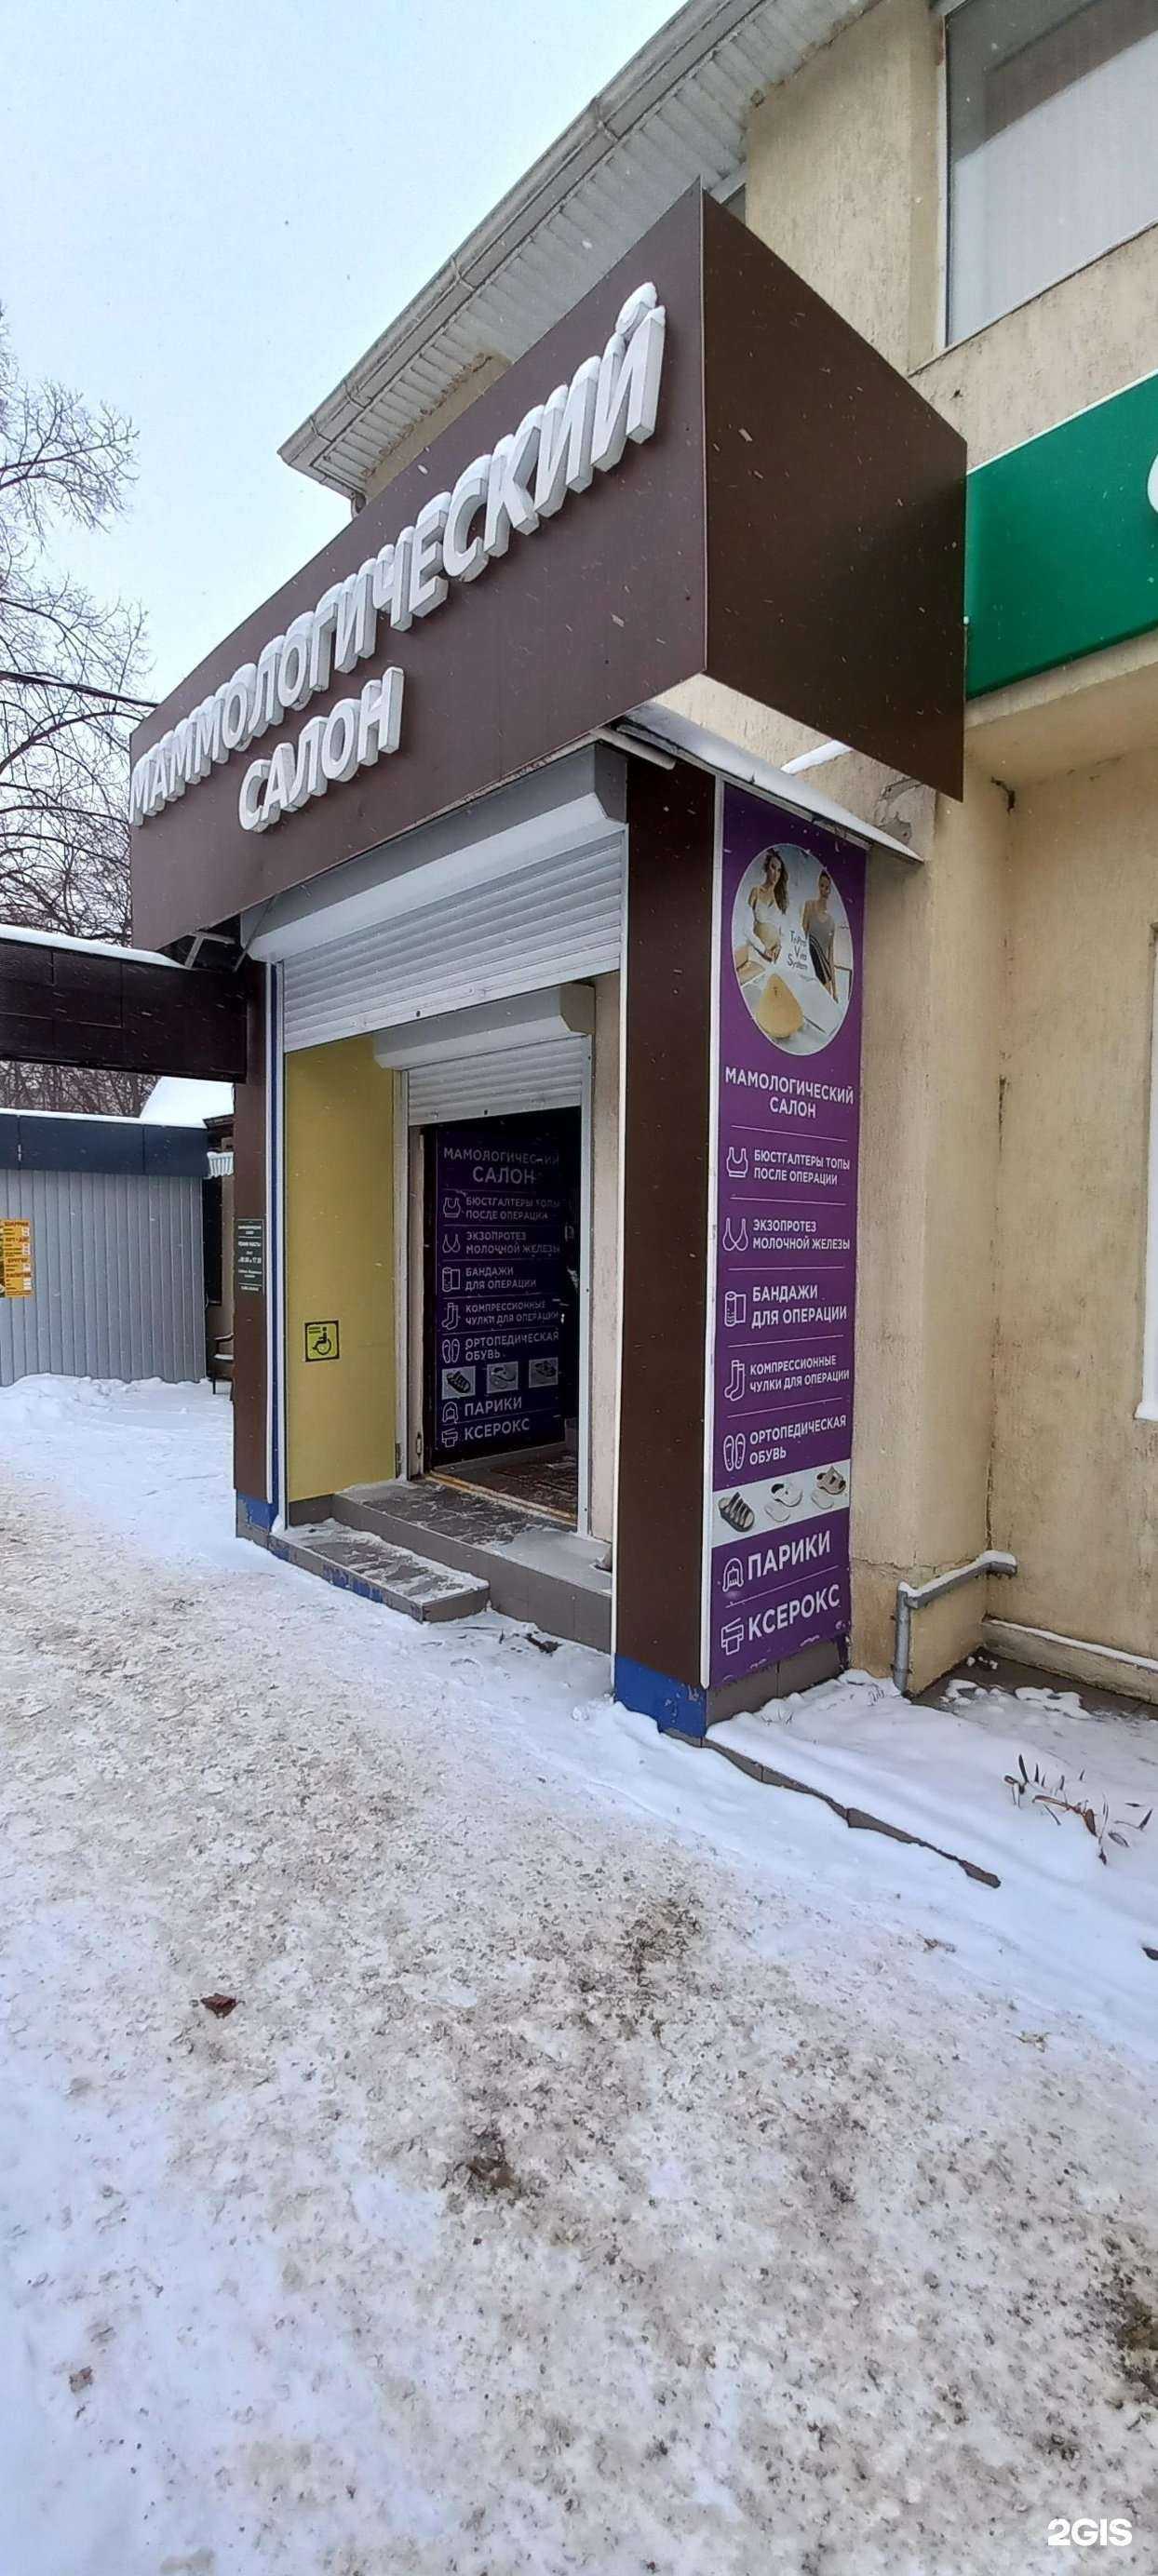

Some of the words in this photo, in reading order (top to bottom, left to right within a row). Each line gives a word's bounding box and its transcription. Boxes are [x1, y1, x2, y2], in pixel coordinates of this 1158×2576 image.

[128, 282, 666, 826] МАММОЛОГИЧЕСКИЙ
[239, 666, 404, 832] САЛОН
[725, 1067, 854, 1104] МАМОЛОГИЧЕСКИЙ
[770, 1097, 816, 1118] САЛОН
[754, 1149, 824, 1169] БЮСТГАЛТЕРЫ
[826, 1157, 850, 1170] ТОПЫ
[473, 1166, 535, 1185] САЛОН
[754, 1168, 788, 1181] ПОСЛЕ
[789, 1171, 838, 1186] ОПЕРАЦИИ
[465, 1197, 533, 1207] БЮСТГАЛТЕРЫ
[465, 1210, 497, 1220] ПОСЛЕ
[753, 1219, 816, 1232] ЭКЗОПРОТЕЗ
[465, 1231, 526, 1241] ЭКЗОПРОТЕЗ
[753, 1235, 810, 1250] МОЛОЧНОЙ
[812, 1239, 850, 1250] ЖЕЛЕЗЫ
[465, 1242, 519, 1254] МОЛОЧНОЙ
[465, 1267, 514, 1278] БАНДАЖИ
[465, 1281, 486, 1292] ДЛЯ
[488, 1280, 537, 1289] ОПЕРАЦИИ
[752, 1285, 818, 1302] БАНДАЖИ
[465, 1301, 545, 1313] КОМПРЕССИОННЫЕ
[465, 1315, 495, 1326] ЧУЛКИ
[496, 1314, 514, 1324] ДЛЯ
[751, 1310, 779, 1329] ДЛЯ
[782, 1306, 847, 1324] ОПЕРАЦИИ
[465, 1331, 559, 1349] ОРТОПЕДИЧЕСКАЯ
[465, 1350, 501, 1362] ОБУВЬ
[750, 1355, 837, 1375] КОМПРЕССИОННЫЕ
[750, 1378, 782, 1392] ЧУЛКИ
[784, 1375, 802, 1389] ДЛЯ
[804, 1369, 850, 1386] ОПЕРАЦИИ
[465, 1397, 522, 1416] ПАРИКИ
[465, 1418, 530, 1440] КСЕРОКС
[749, 1415, 847, 1444] ОРТОПЕДИЧЕСКАЯ
[749, 1448, 787, 1466] ОБУВЬ
[747, 1530, 830, 1580] ПАРИКИ
[748, 1584, 840, 1641] КСЕРОКС
